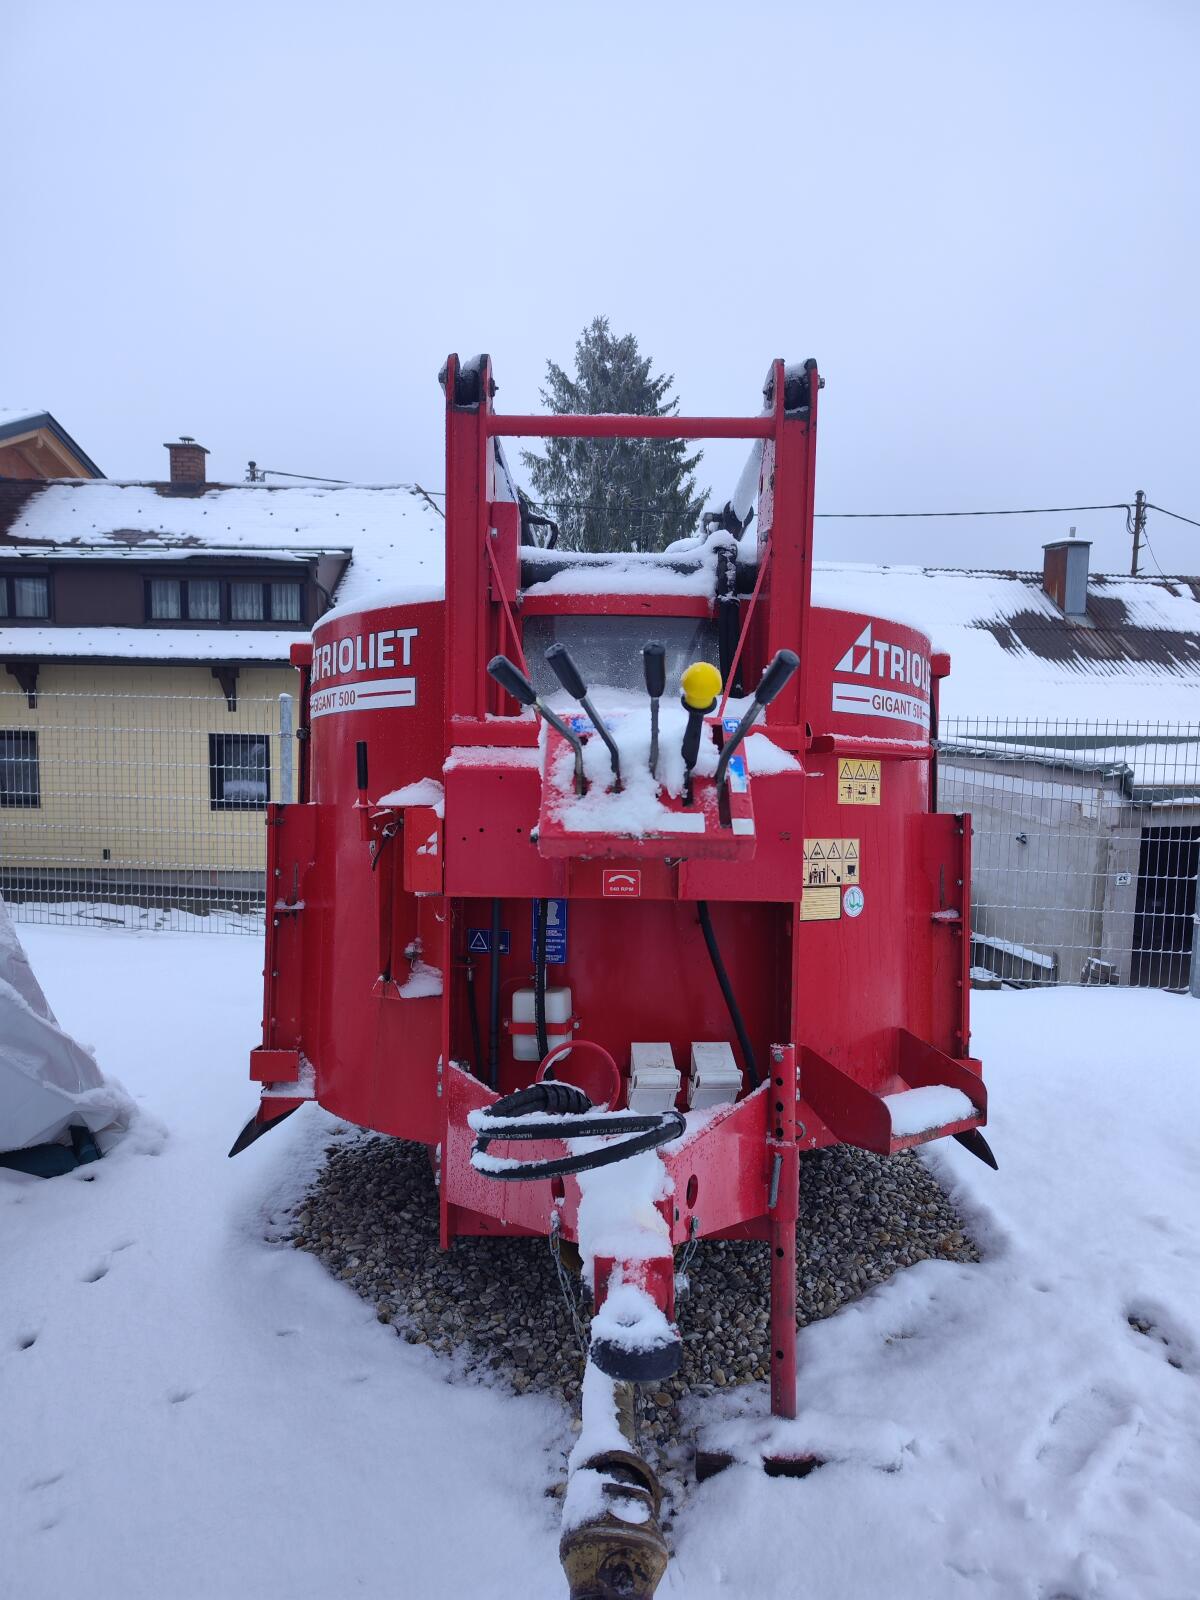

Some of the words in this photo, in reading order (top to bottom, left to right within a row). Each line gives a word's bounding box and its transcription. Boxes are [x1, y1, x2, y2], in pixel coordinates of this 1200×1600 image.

[315, 627, 418, 681] TRIOLIET
[313, 692, 337, 713] GIGANT
[339, 690, 356, 707] 500
[872, 694, 912, 716] GIGANT
[912, 703, 923, 720] 500
